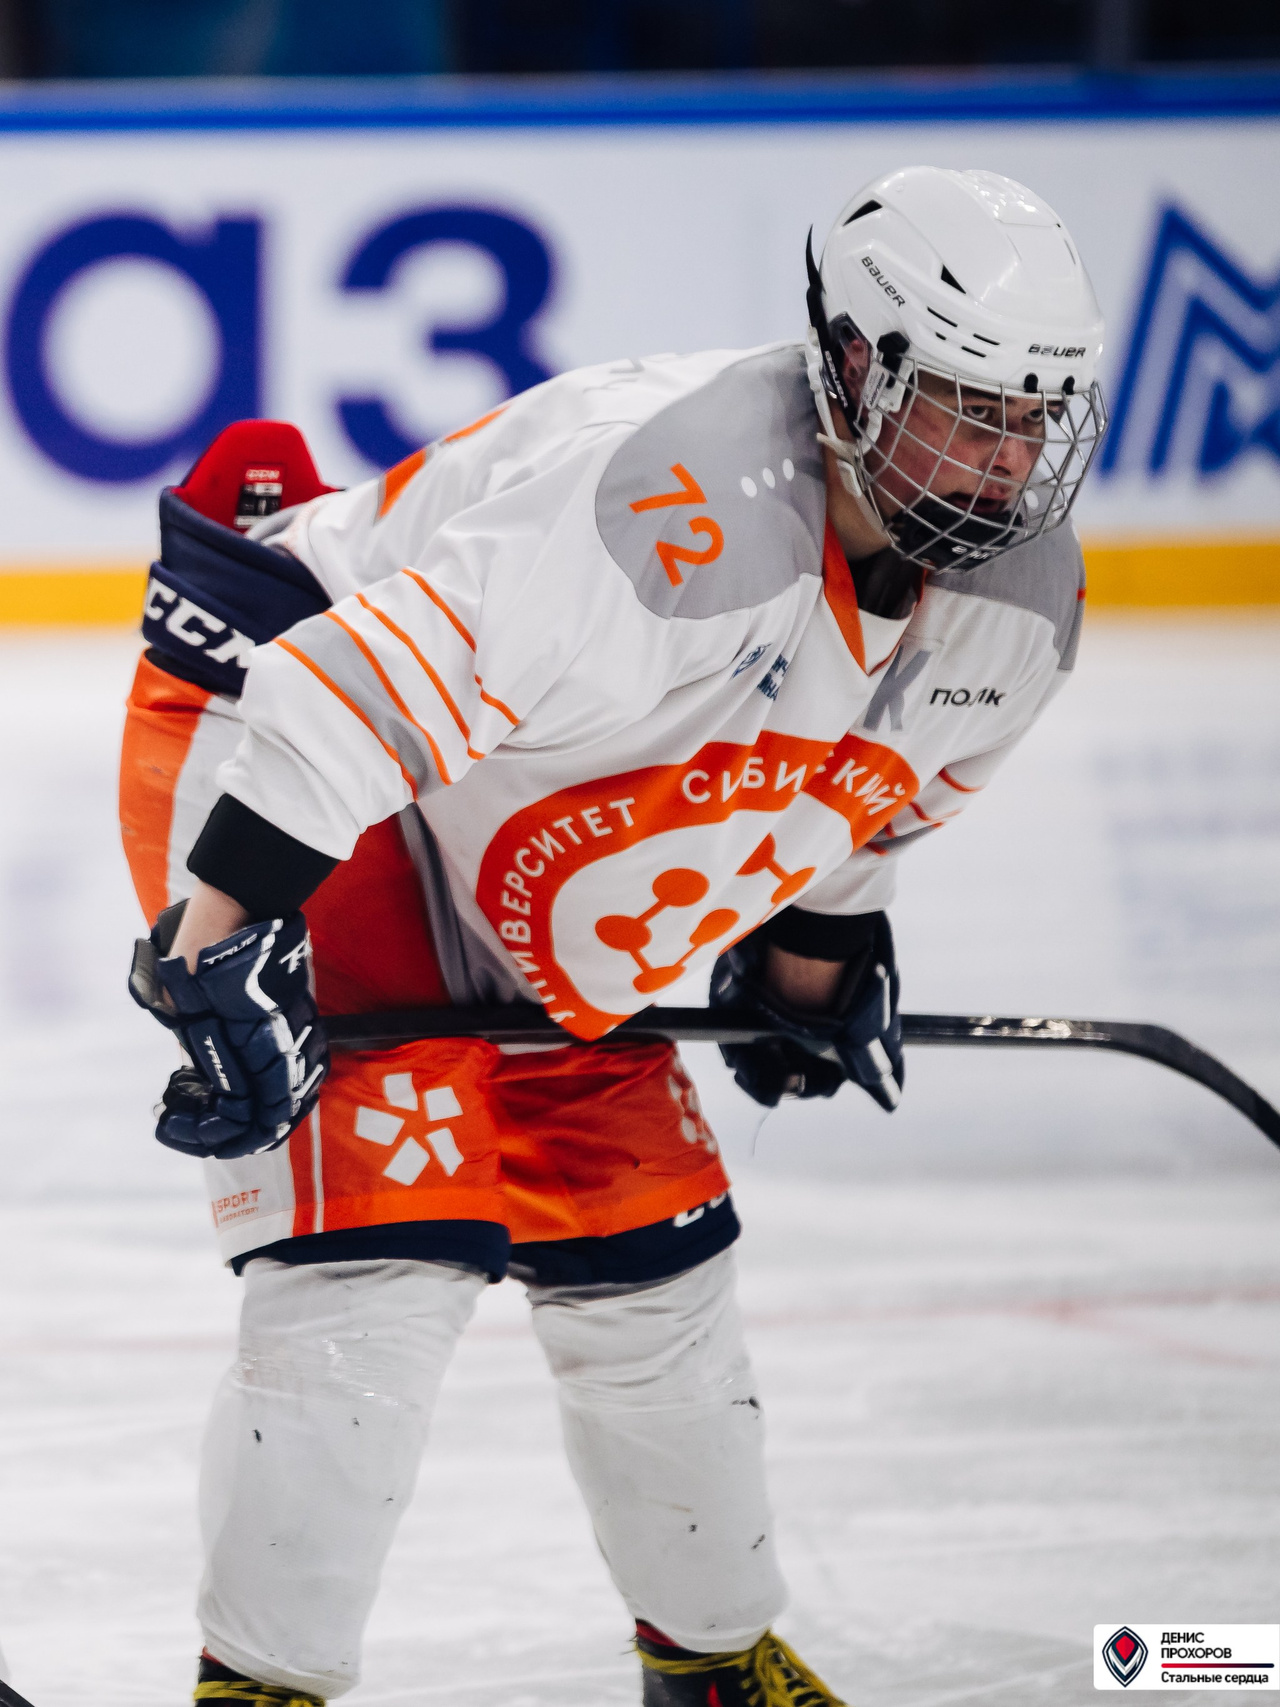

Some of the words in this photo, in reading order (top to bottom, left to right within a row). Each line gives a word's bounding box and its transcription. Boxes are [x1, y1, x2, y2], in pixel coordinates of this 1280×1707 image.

[861, 256, 906, 307] BAUER
[1028, 343, 1086, 358] BAUER
[628, 463, 725, 588] 72
